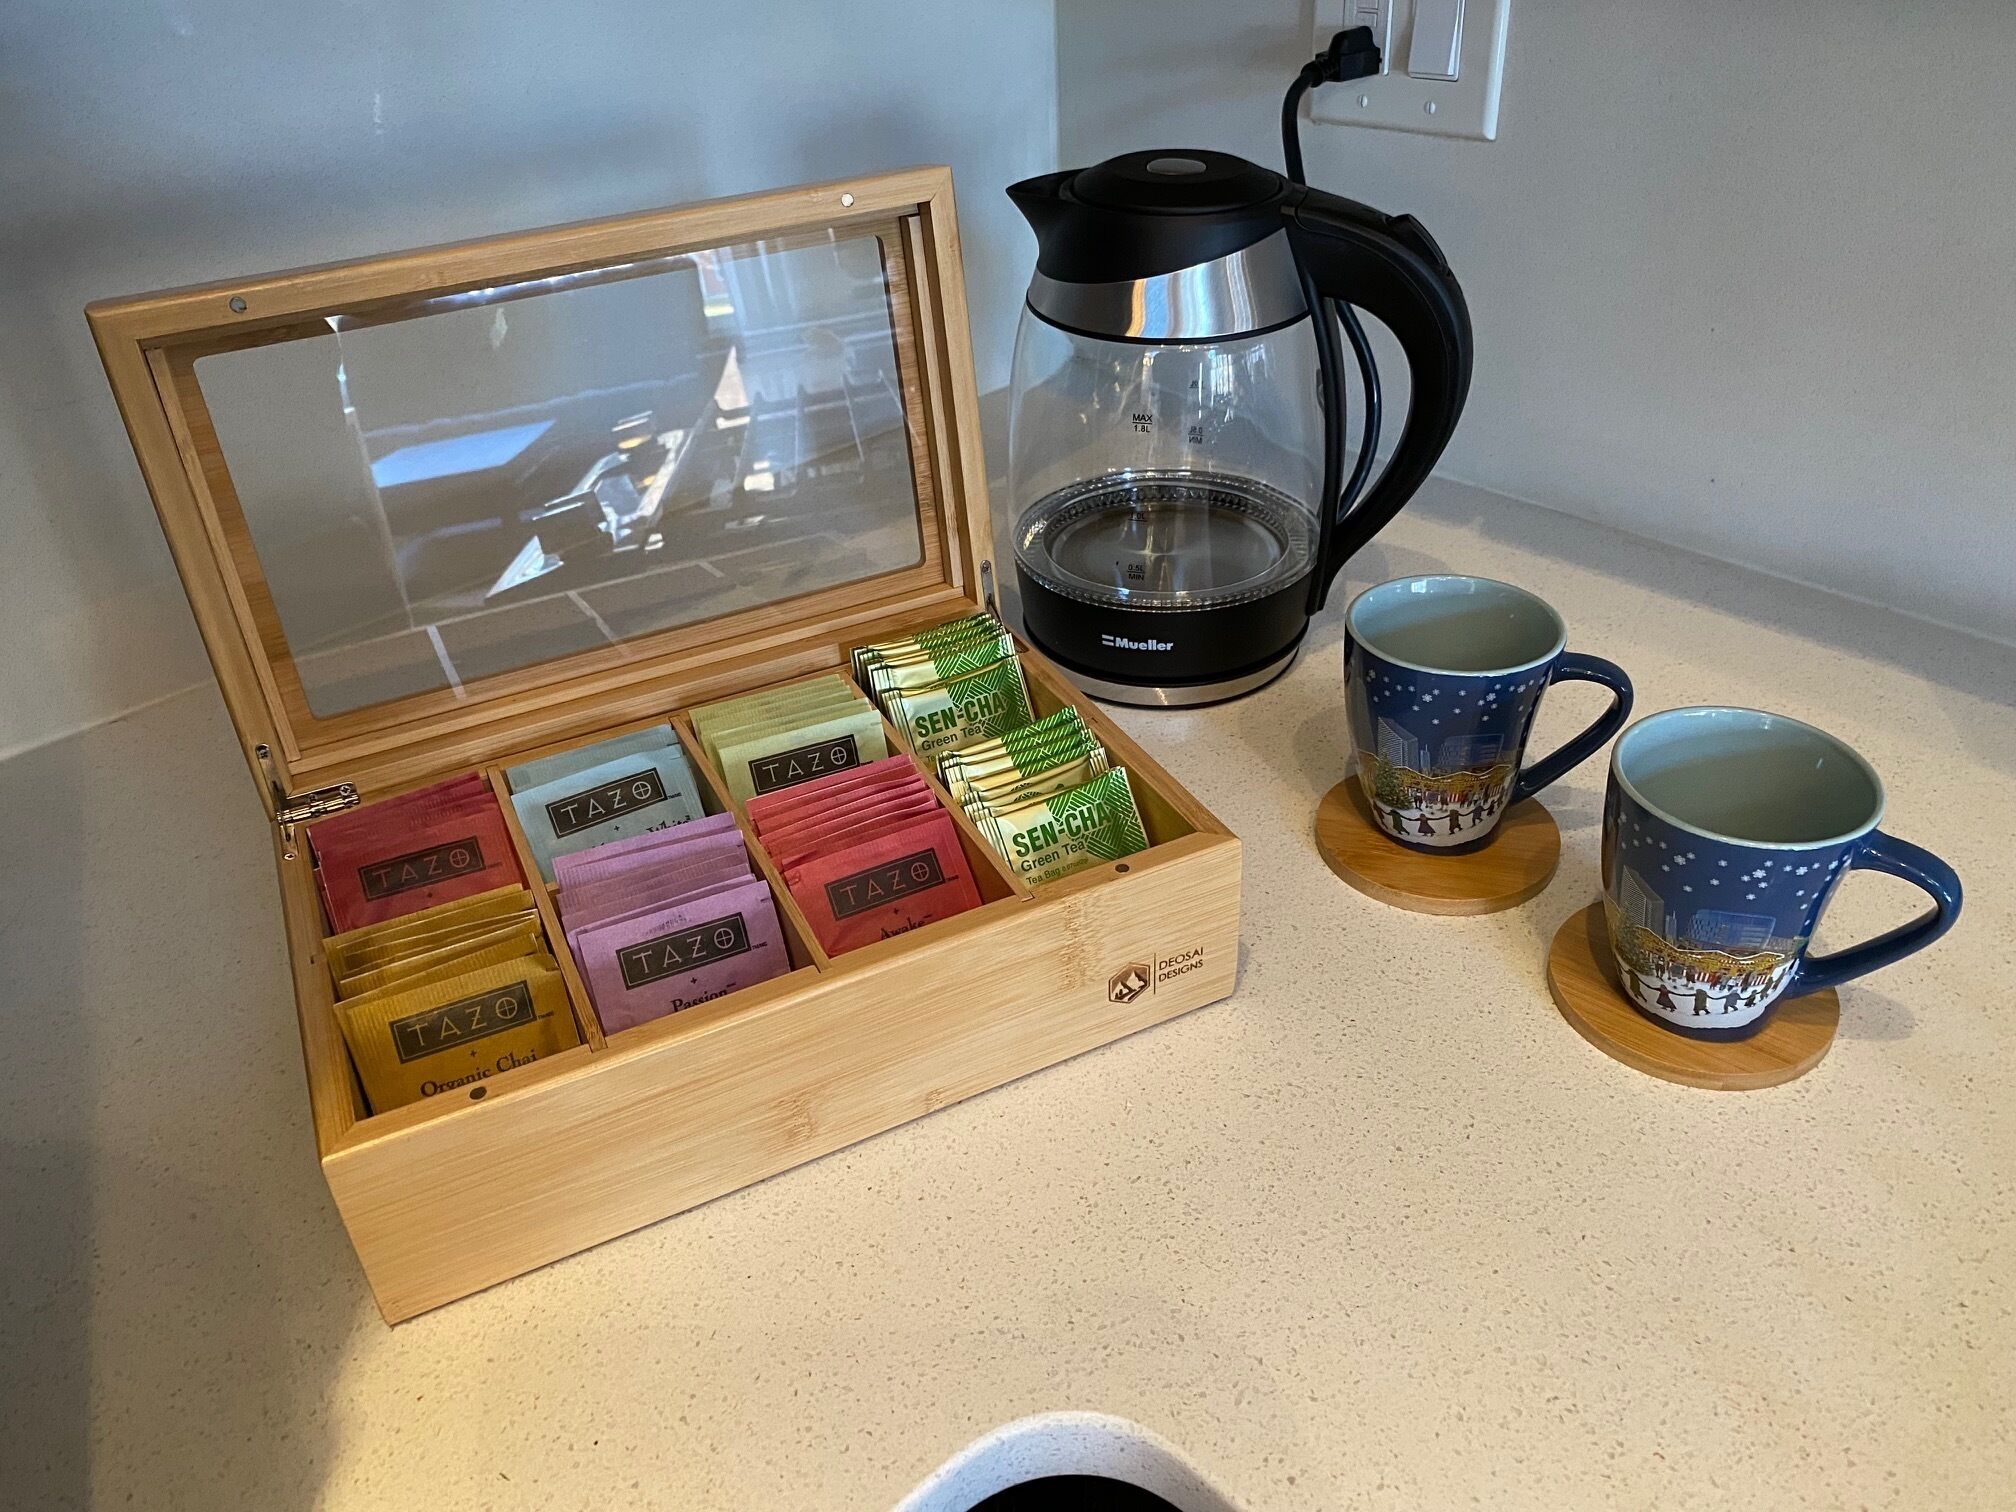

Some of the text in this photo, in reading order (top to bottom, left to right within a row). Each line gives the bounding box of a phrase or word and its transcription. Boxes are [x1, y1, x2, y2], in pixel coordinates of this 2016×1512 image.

[1132, 413, 1153, 422] MAX
[1134, 424, 1151, 433] 1.8L
[1128, 573, 1145, 581] MIN
[1115, 637, 1174, 651] Mueller
[914, 690, 1006, 738] SEN-CHA
[921, 725, 982, 751] Green Tea
[762, 746, 847, 782] TAZO
[560, 781, 652, 824] TAZO
[1012, 800, 1112, 857] SEN-CHA
[372, 848, 470, 888] TAZO
[1020, 850, 1060, 872] Green
[1061, 840, 1086, 856] Tea
[840, 862, 930, 905] TAZO
[1026, 874, 1043, 886] Tea
[632, 927, 735, 973] TAZO
[1159, 946, 1204, 971] DEOSAI
[1159, 959, 1204, 982] DESIGNS
[407, 997, 517, 1046] TAZO
[496, 1048, 538, 1073] Chai
